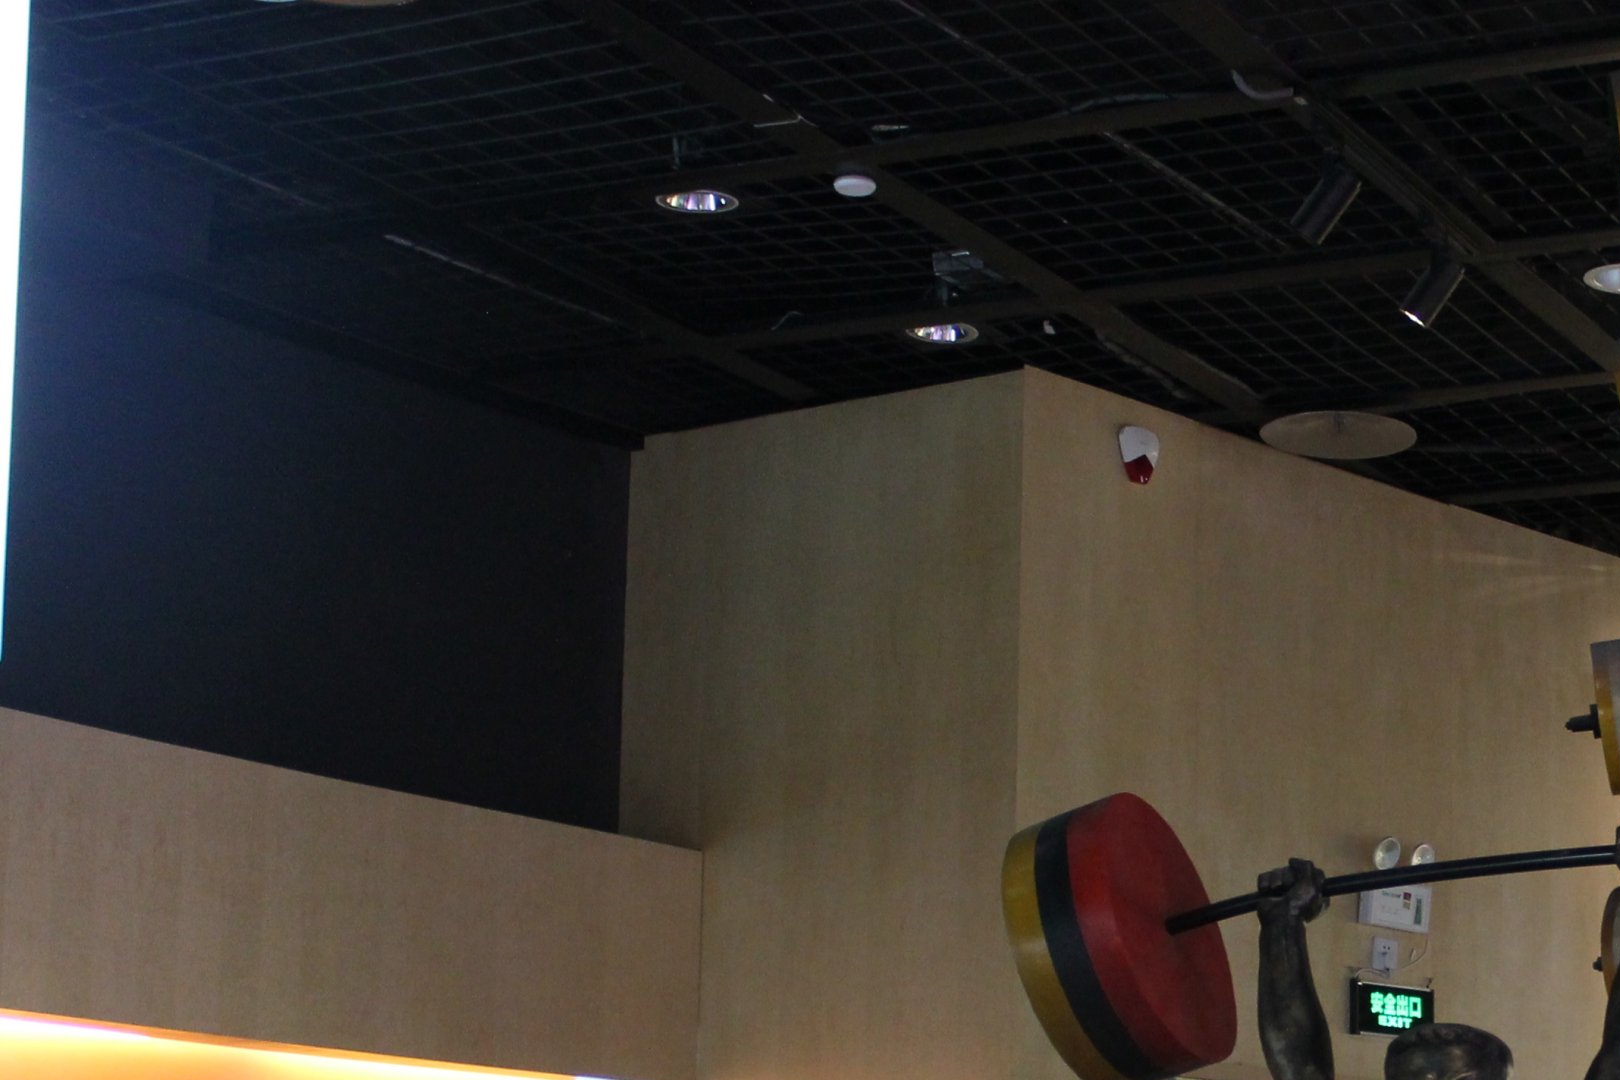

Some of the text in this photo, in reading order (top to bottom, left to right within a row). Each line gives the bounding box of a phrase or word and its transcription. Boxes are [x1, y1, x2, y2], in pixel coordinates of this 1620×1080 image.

[1371, 992, 1422, 1018] 安全出口
[1378, 1015, 1412, 1029] EXIT
